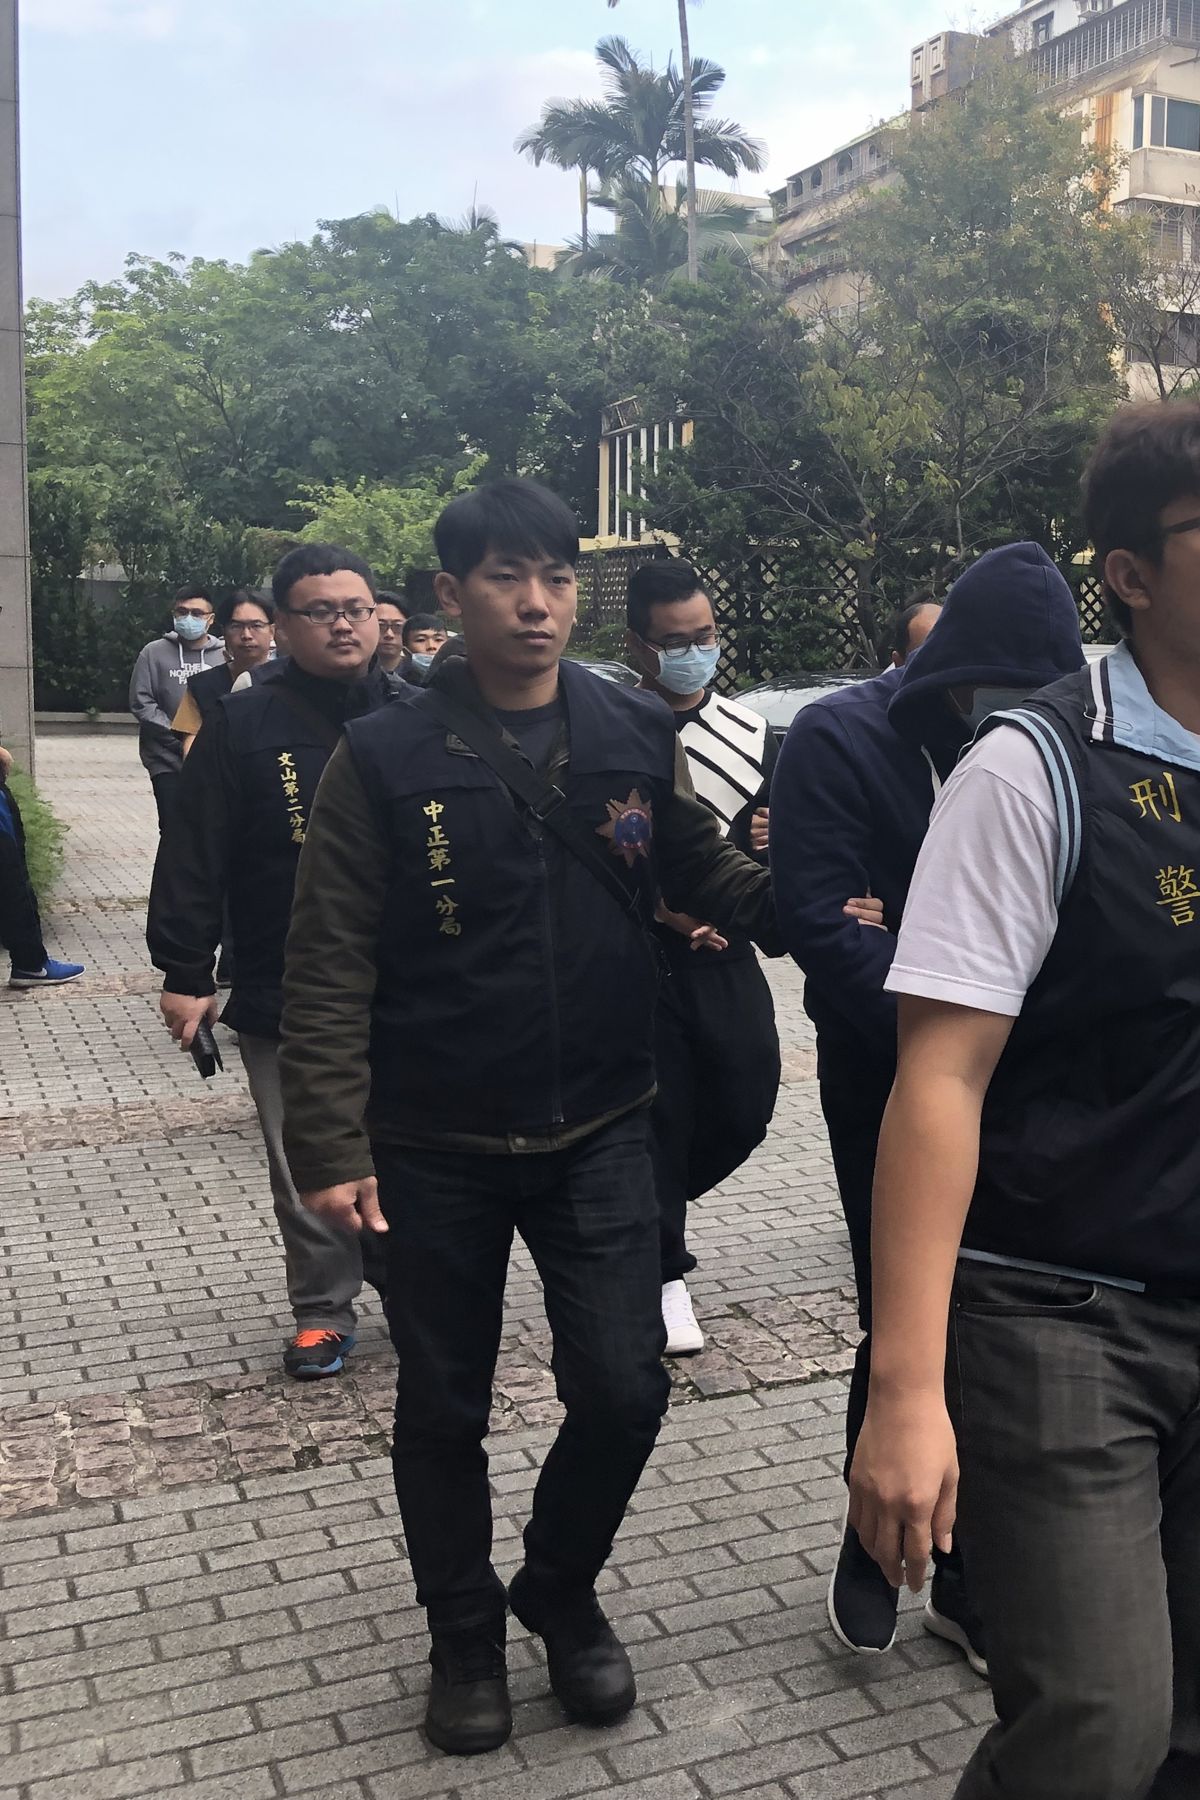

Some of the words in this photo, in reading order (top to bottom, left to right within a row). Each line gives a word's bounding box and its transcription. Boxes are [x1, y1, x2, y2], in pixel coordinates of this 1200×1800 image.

[277, 752, 306, 844] 文山第二分局
[422, 800, 462, 936] 中正第一分局
